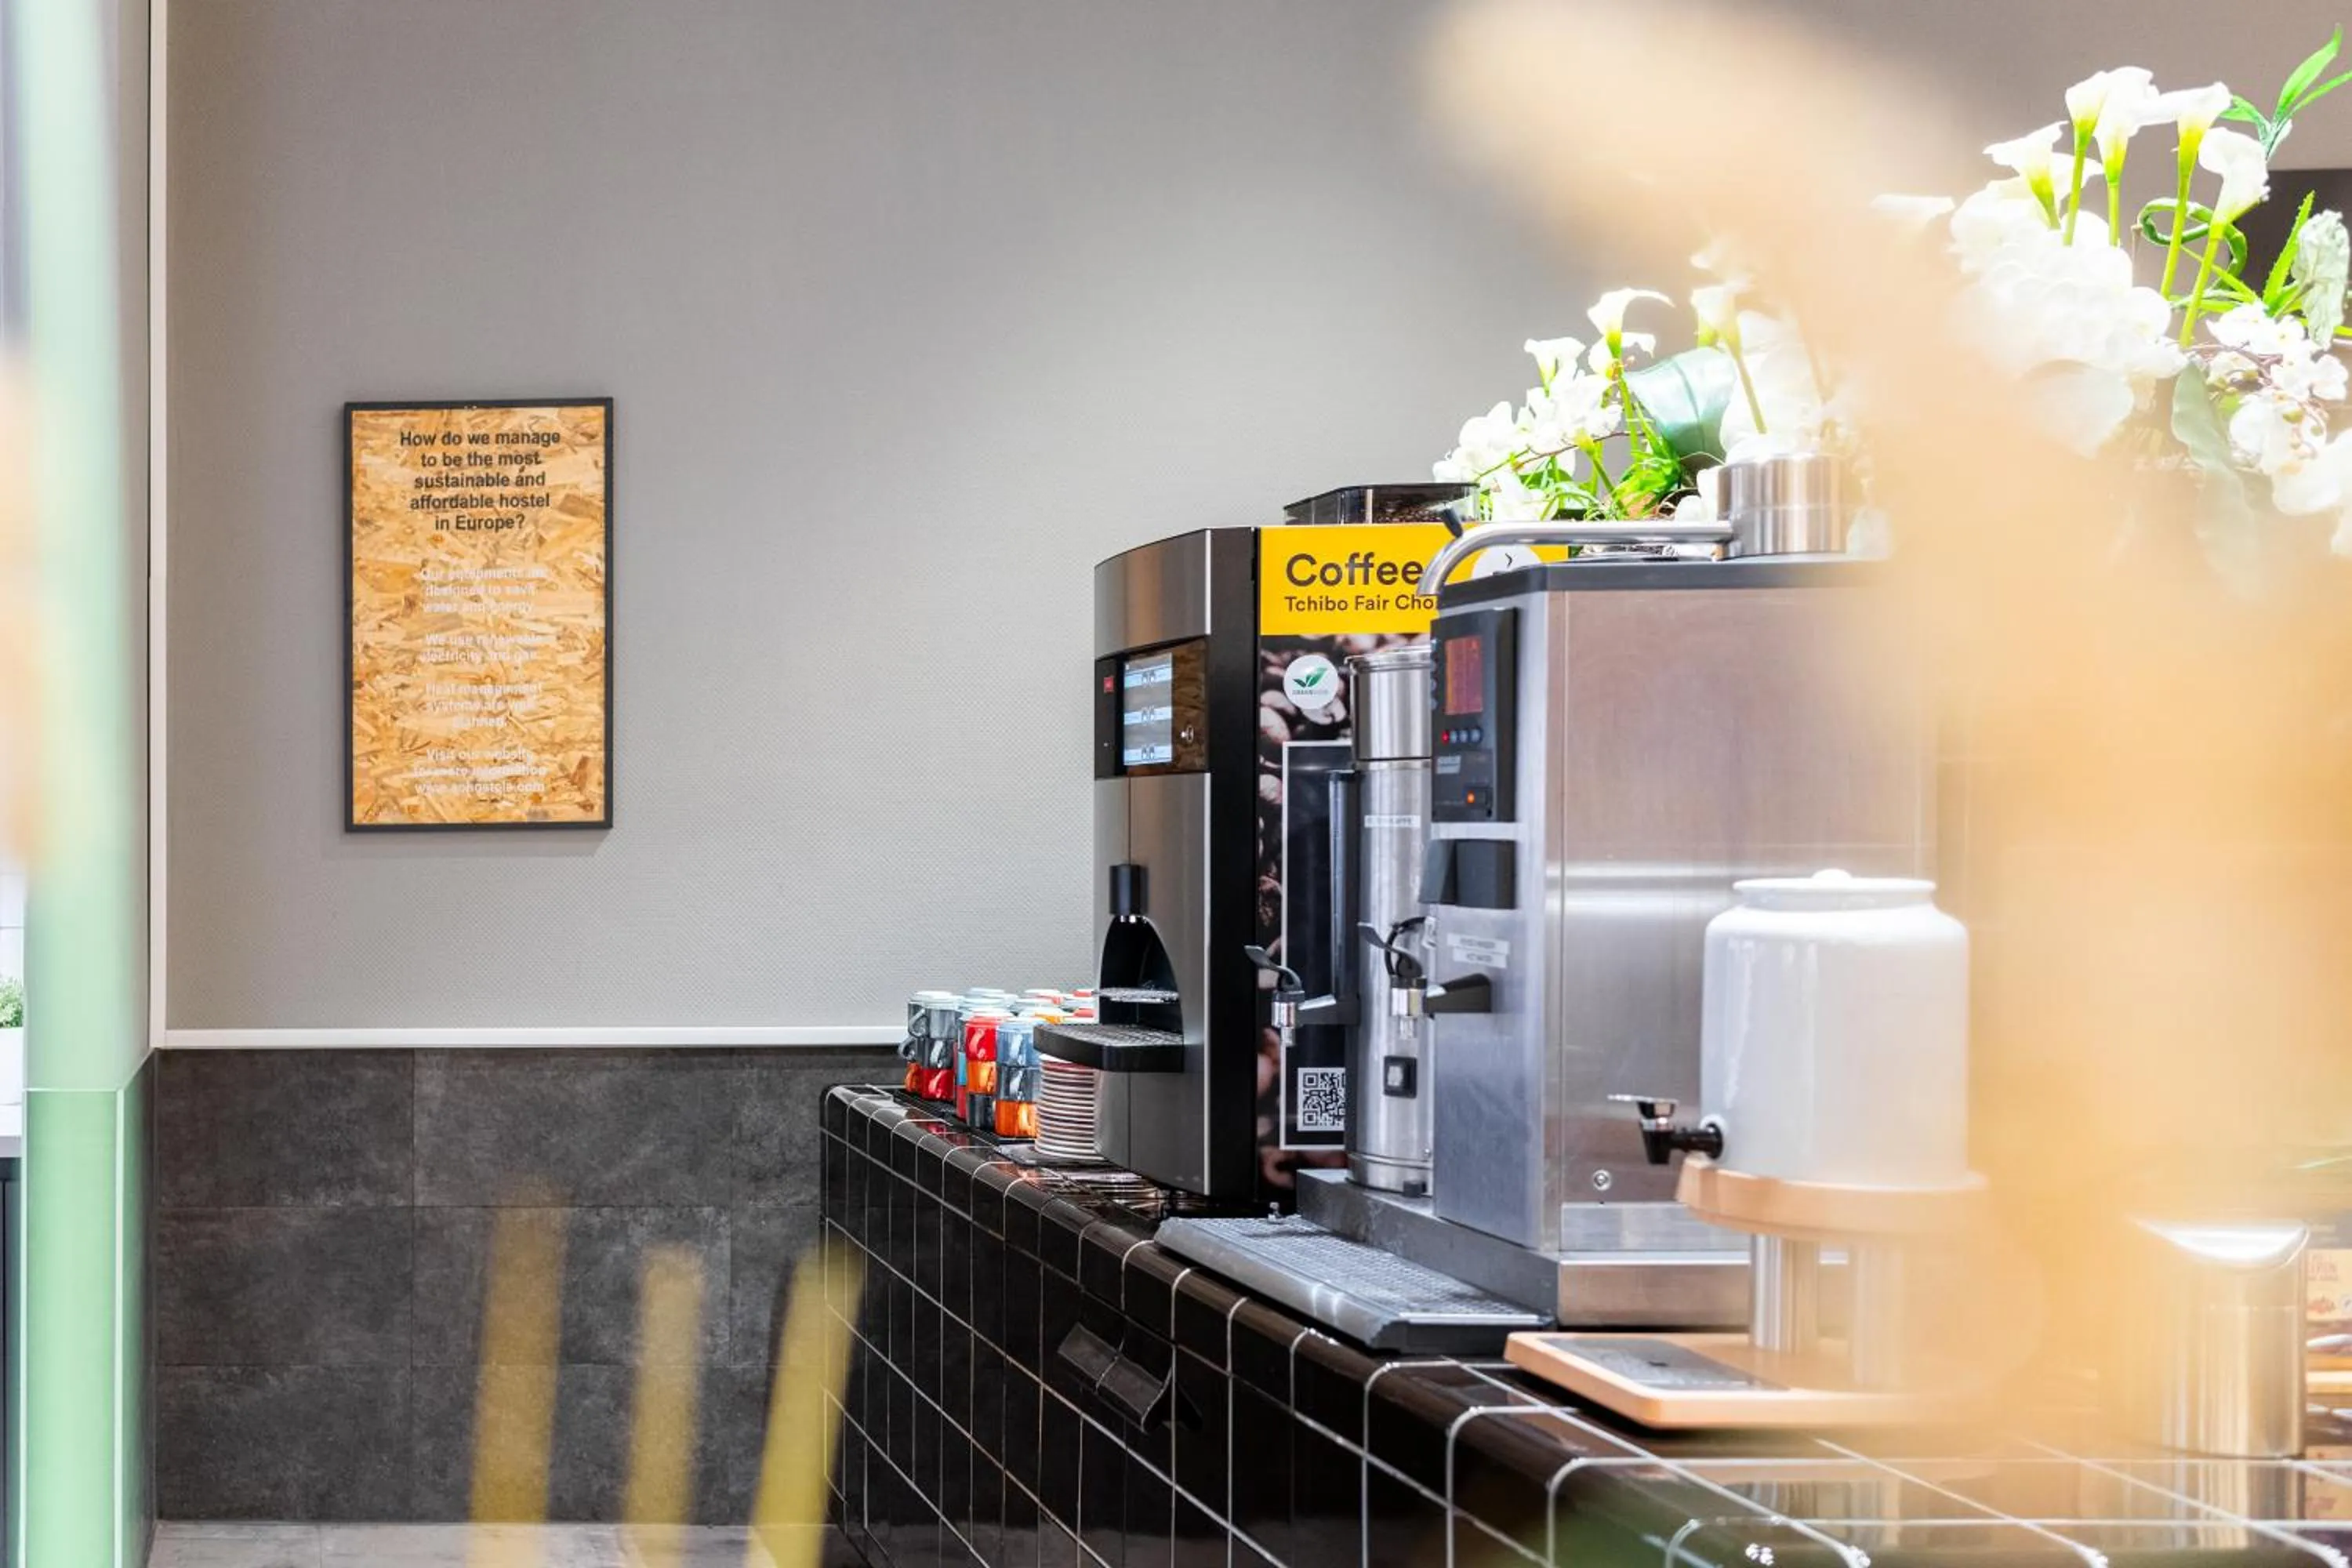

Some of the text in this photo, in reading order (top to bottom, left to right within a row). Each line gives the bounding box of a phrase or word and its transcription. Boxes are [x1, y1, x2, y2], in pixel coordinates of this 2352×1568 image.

[400, 431, 561, 447] How do we manage
[421, 451, 541, 467] to be the most
[414, 471, 546, 489] sustainable and
[410, 493, 550, 510] affordable hostel
[435, 514, 525, 532] in Europe?
[1286, 552, 1424, 587] Coffee
[1284, 594, 1437, 612] Tchibo Fair Cho
